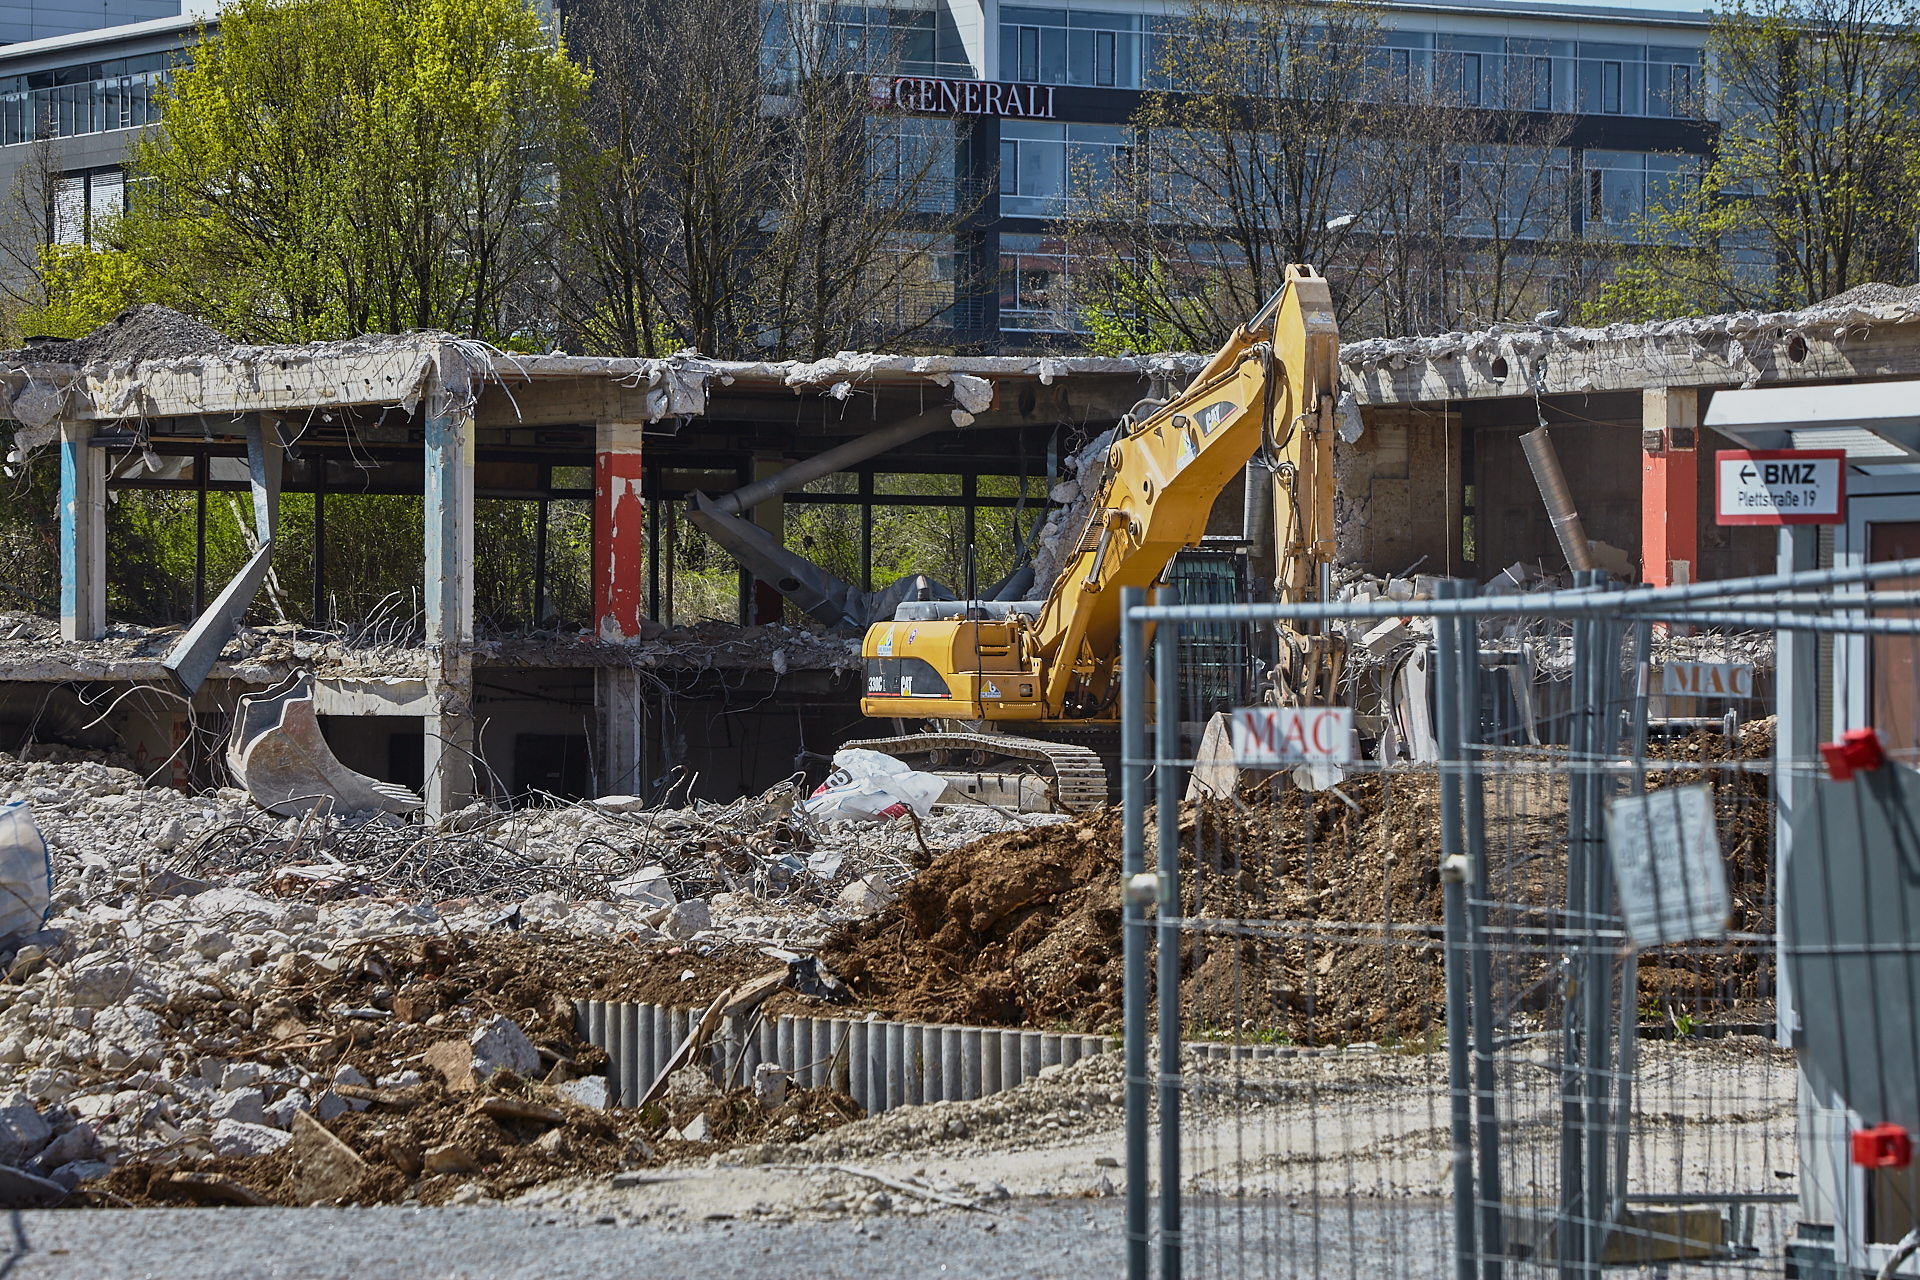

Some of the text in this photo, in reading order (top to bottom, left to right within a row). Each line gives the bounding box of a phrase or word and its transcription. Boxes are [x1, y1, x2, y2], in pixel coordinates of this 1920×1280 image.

[894, 78, 1057, 118] GENERALI
[1205, 403, 1221, 433] CAT
[1764, 464, 1816, 484] BMZ
[1738, 490, 1817, 507] Plettstraße 19
[900, 675, 913, 697] CAT
[1671, 665, 1751, 695] MAC
[1243, 710, 1341, 755] MAC
